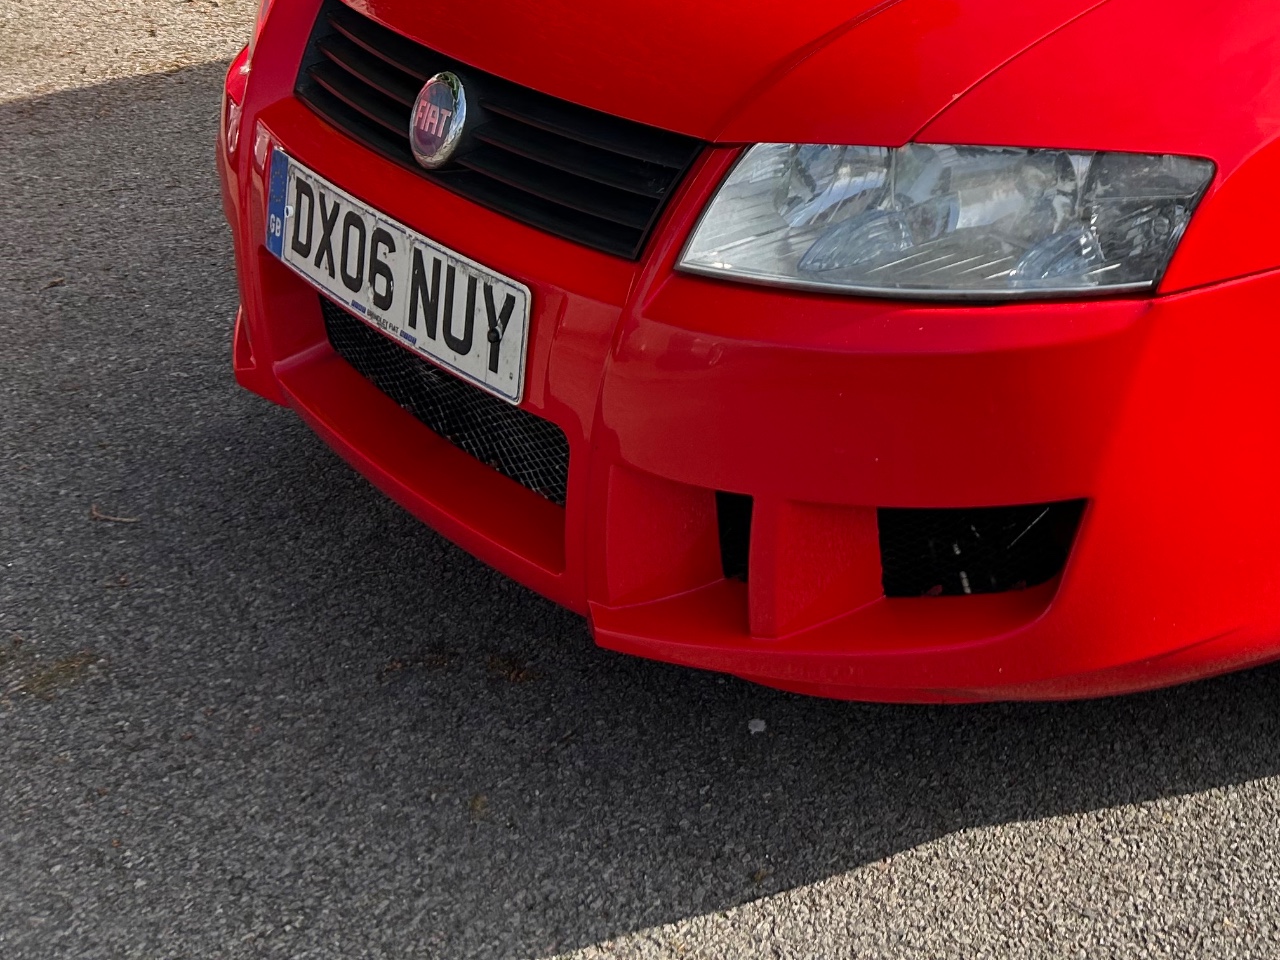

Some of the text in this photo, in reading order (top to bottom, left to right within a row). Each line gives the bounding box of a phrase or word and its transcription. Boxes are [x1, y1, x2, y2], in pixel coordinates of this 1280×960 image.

[414, 99, 452, 138] FIAT
[270, 213, 281, 237] GB
[290, 176, 516, 374] DX06 NUY
